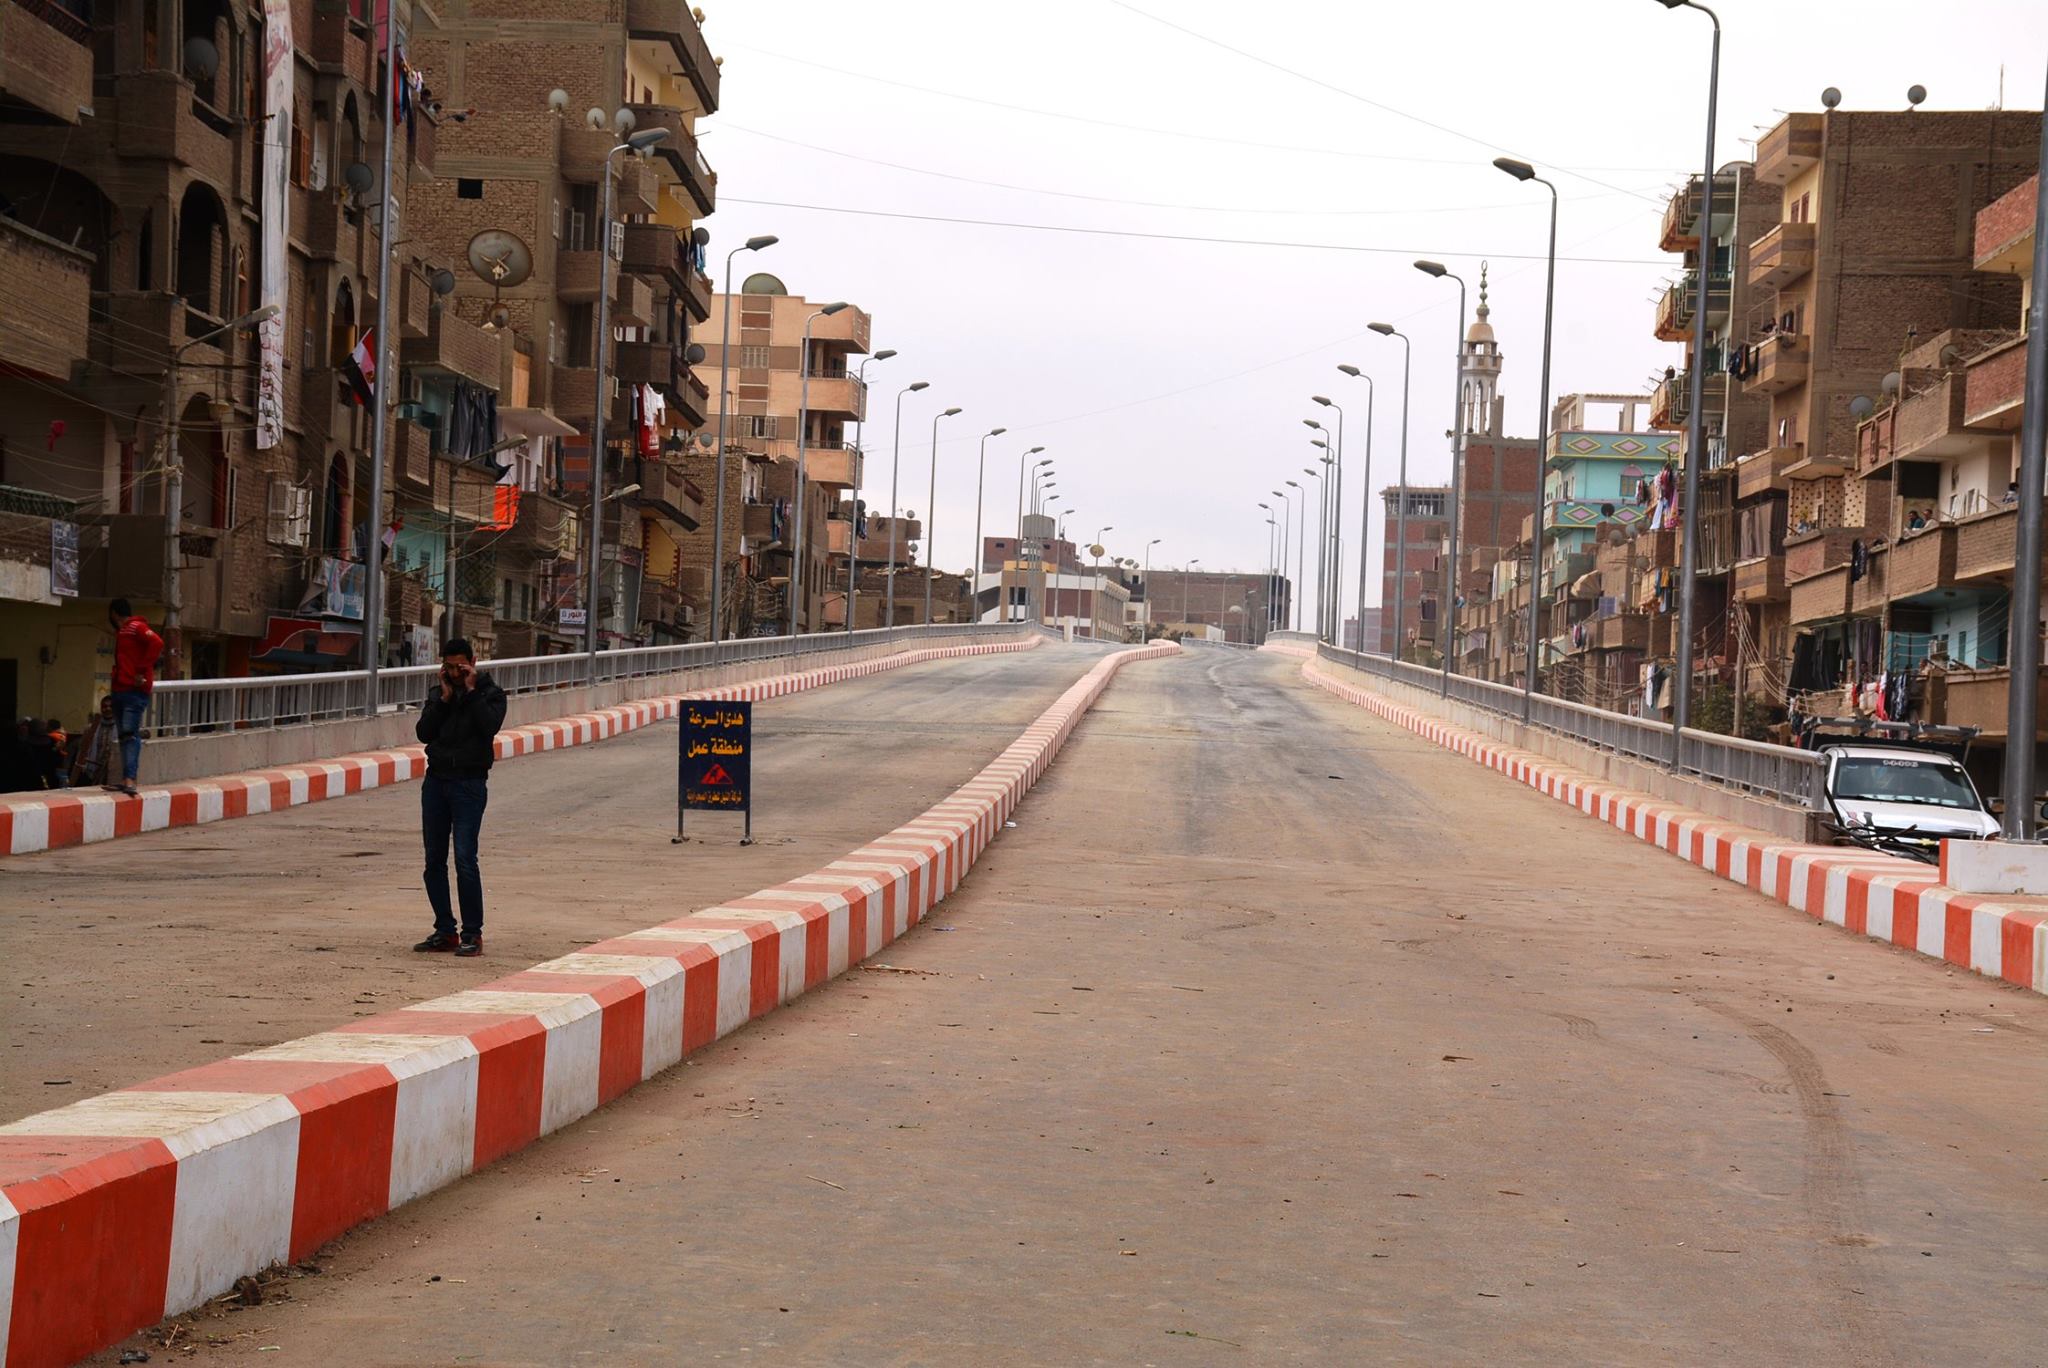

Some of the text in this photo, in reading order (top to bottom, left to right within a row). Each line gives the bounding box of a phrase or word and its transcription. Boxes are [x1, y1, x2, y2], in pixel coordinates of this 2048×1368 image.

[689, 707, 723, 729] السرعة
[688, 737, 744, 758] منطقة عمل
